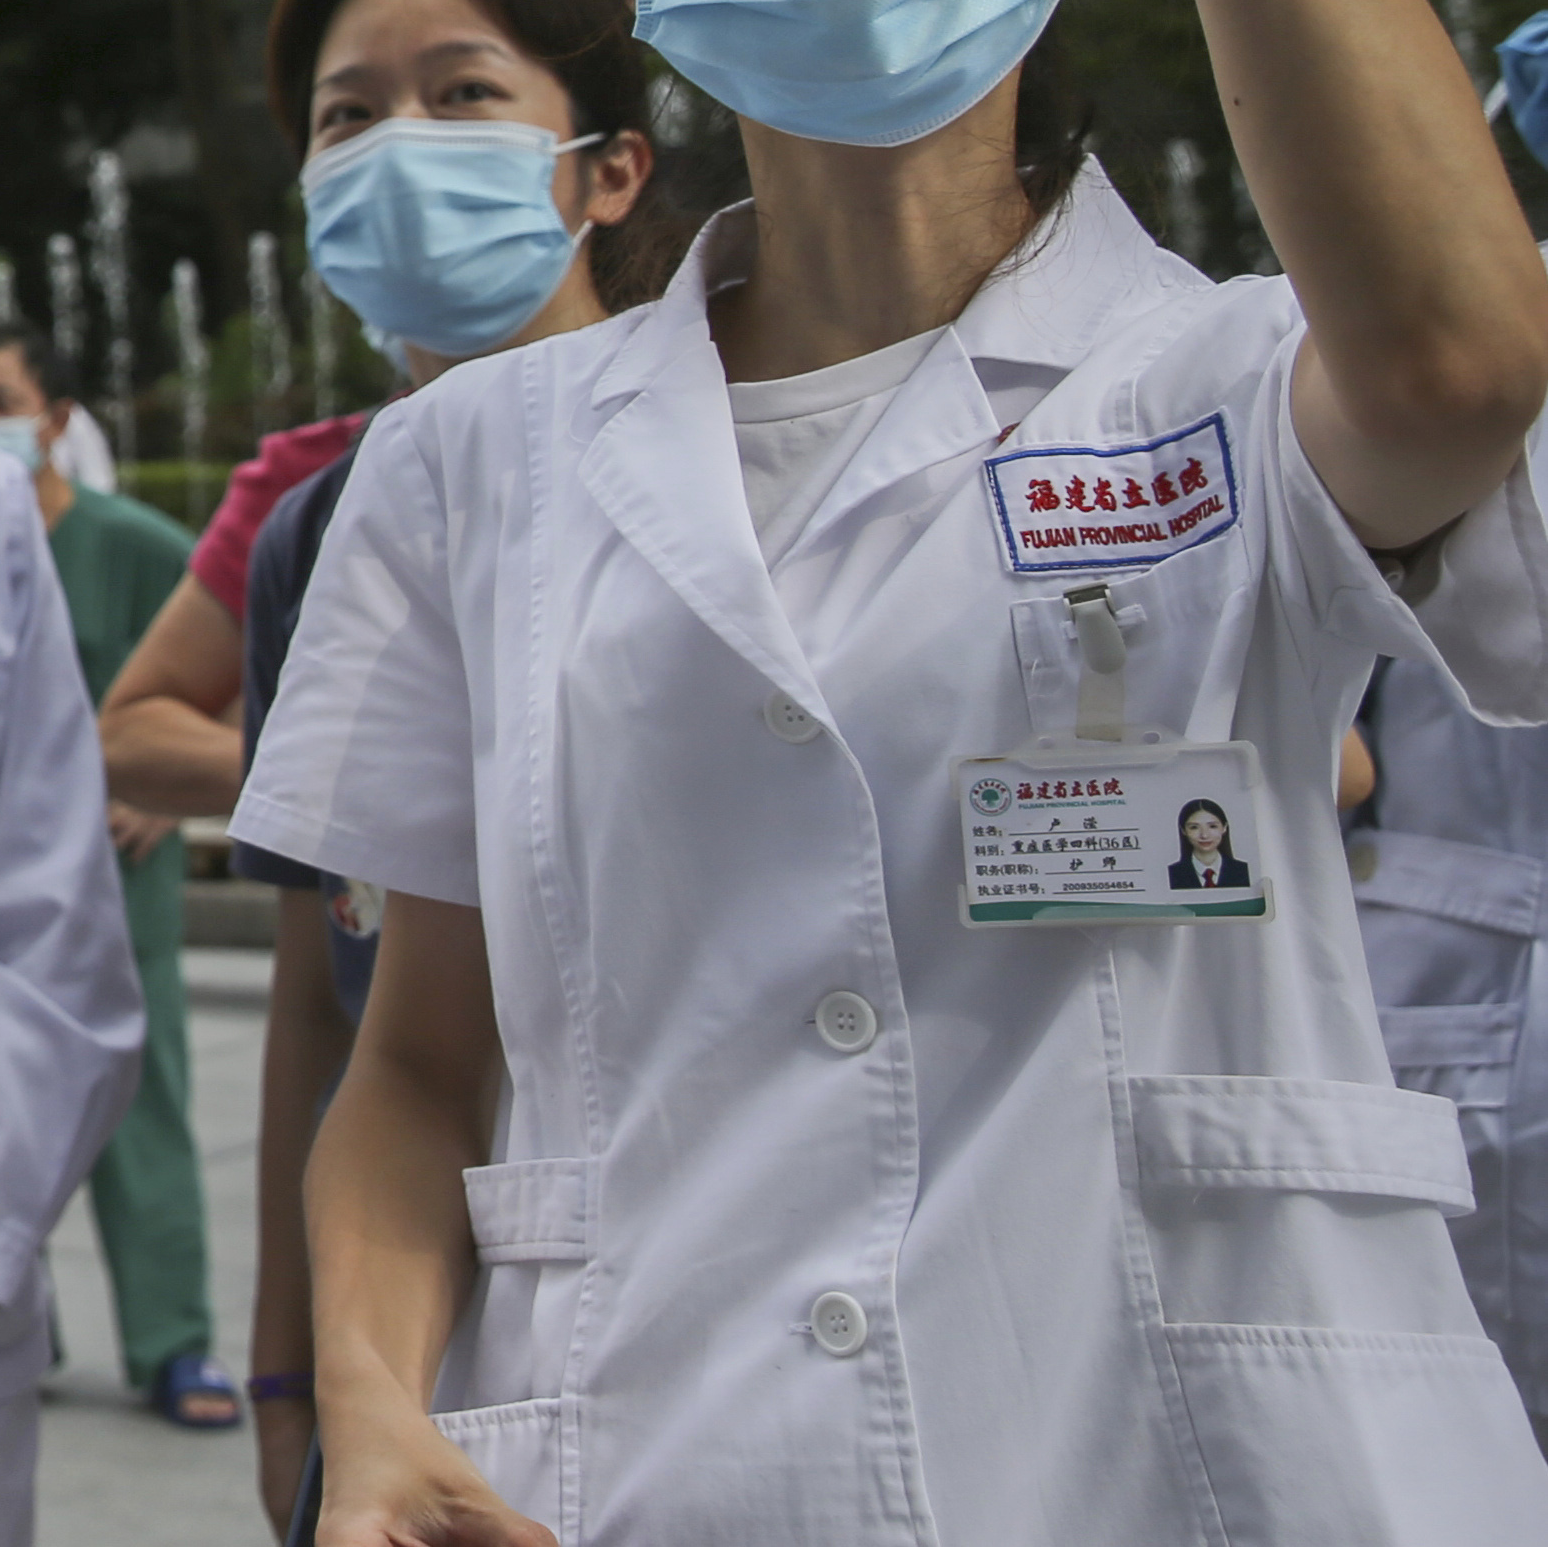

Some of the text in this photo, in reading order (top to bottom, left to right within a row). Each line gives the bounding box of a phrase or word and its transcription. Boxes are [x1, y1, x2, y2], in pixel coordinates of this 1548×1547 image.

[1025, 457, 1208, 512] 福建省立医院
[1019, 494, 1225, 549] FUJIAN PROVINCIAL HOSPITAL
[1016, 777, 1124, 800] 福建省立医院
